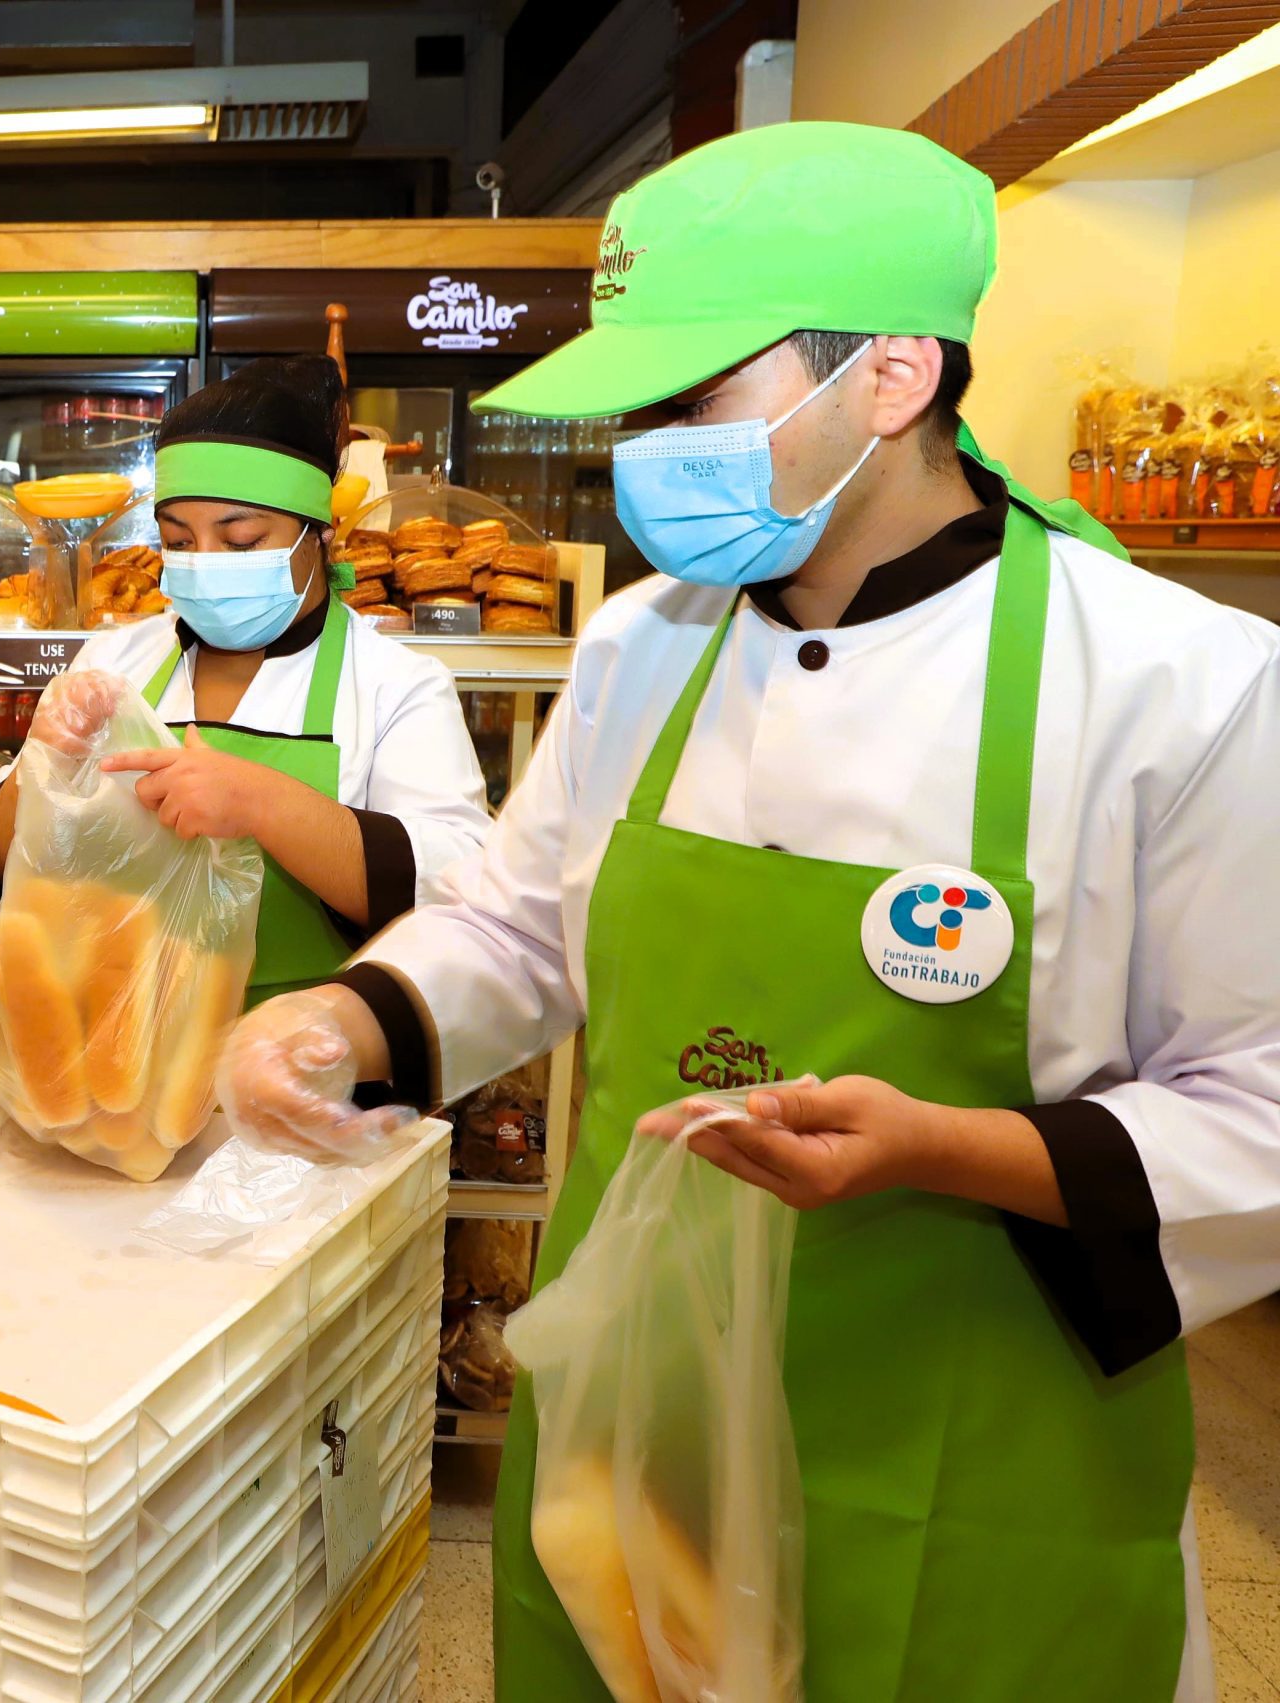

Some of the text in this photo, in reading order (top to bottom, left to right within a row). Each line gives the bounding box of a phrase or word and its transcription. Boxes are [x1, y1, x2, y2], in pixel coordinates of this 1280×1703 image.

[428, 275, 481, 305] San
[407, 294, 529, 335] Camilo
[682, 459, 724, 473] DEYSA
[40, 644, 65, 657] USE
[24, 663, 68, 676] TENAZ
[883, 948, 936, 965] Fundación
[881, 961, 981, 988] ConTRABAJO
[704, 1026, 769, 1066] San
